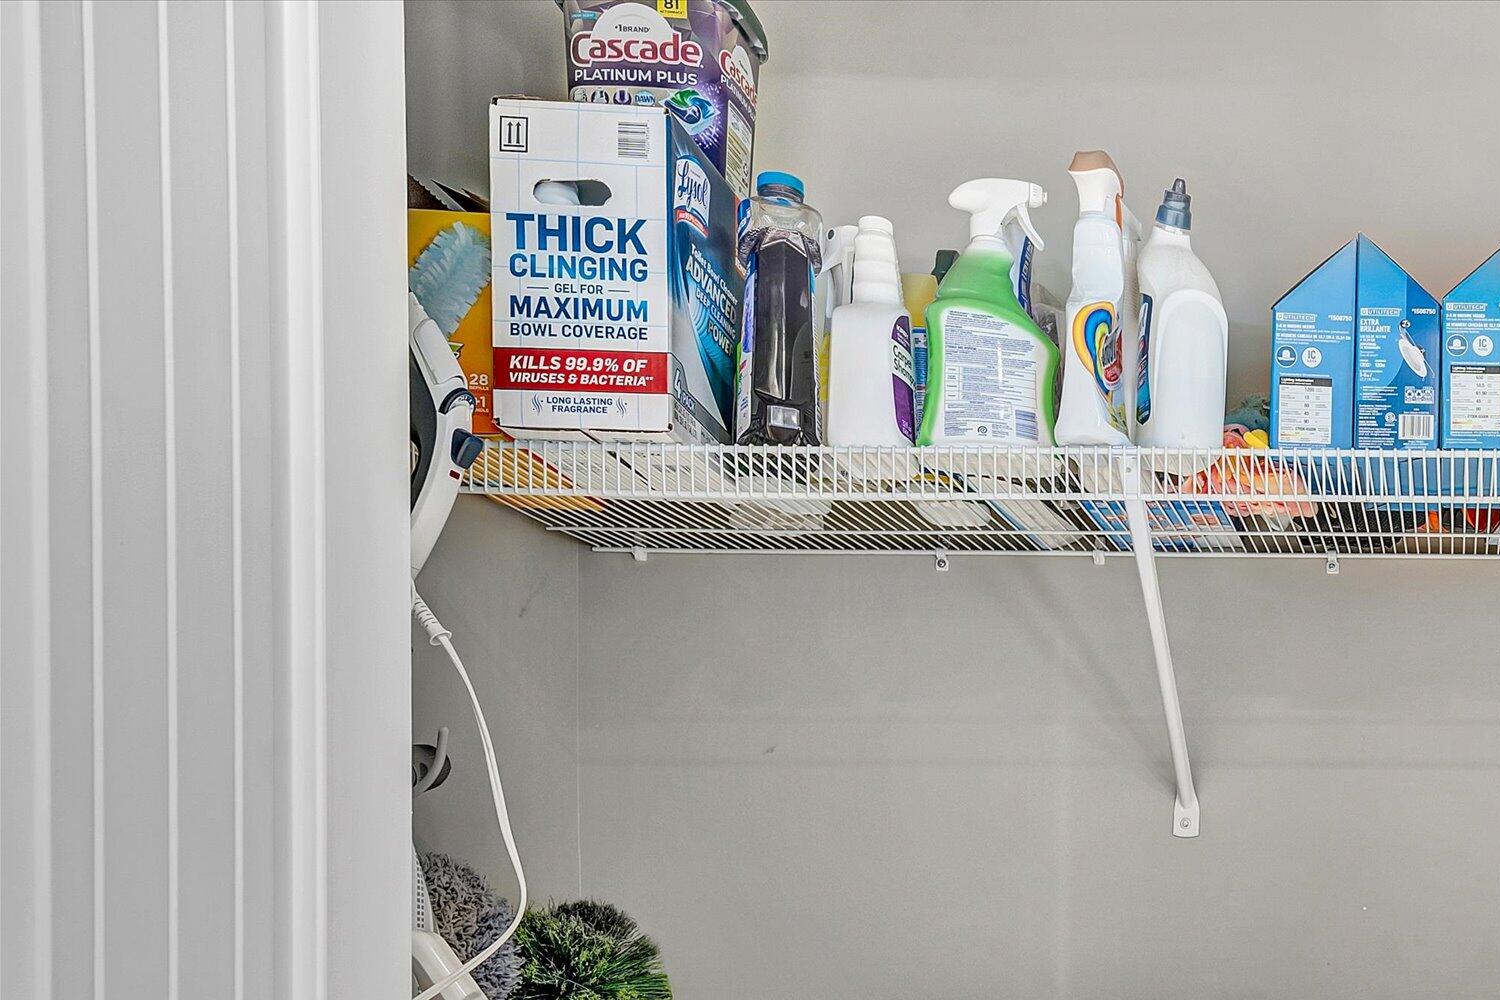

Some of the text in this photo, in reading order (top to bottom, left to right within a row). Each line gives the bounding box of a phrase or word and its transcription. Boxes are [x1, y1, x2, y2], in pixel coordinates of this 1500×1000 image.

[571, 32, 701, 65] Cascade
[575, 69, 698, 85] PLATINUM PLUS
[678, 160, 708, 212] Lysol
[506, 213, 648, 255] THICK
[509, 254, 648, 282] CLINGING
[555, 284, 603, 295] GEL FOR
[685, 255, 737, 325] ADVANCED
[510, 296, 648, 322] MAXIMUM
[696, 289, 736, 339] DEEP CLEANING
[510, 323, 648, 340] BOWL COVERAGE
[1478, 339, 1487, 348] IC
[509, 355, 647, 372] KILLS 99.9% OF
[1307, 350, 1317, 360] IC
[469, 374, 489, 386] 28
[509, 373, 566, 384] VIRUSES
[569, 374, 578, 384] &
[674, 368, 683, 400] 4
[546, 397, 613, 407] LONG LASTING
[552, 405, 608, 414] FRAGRANCE
